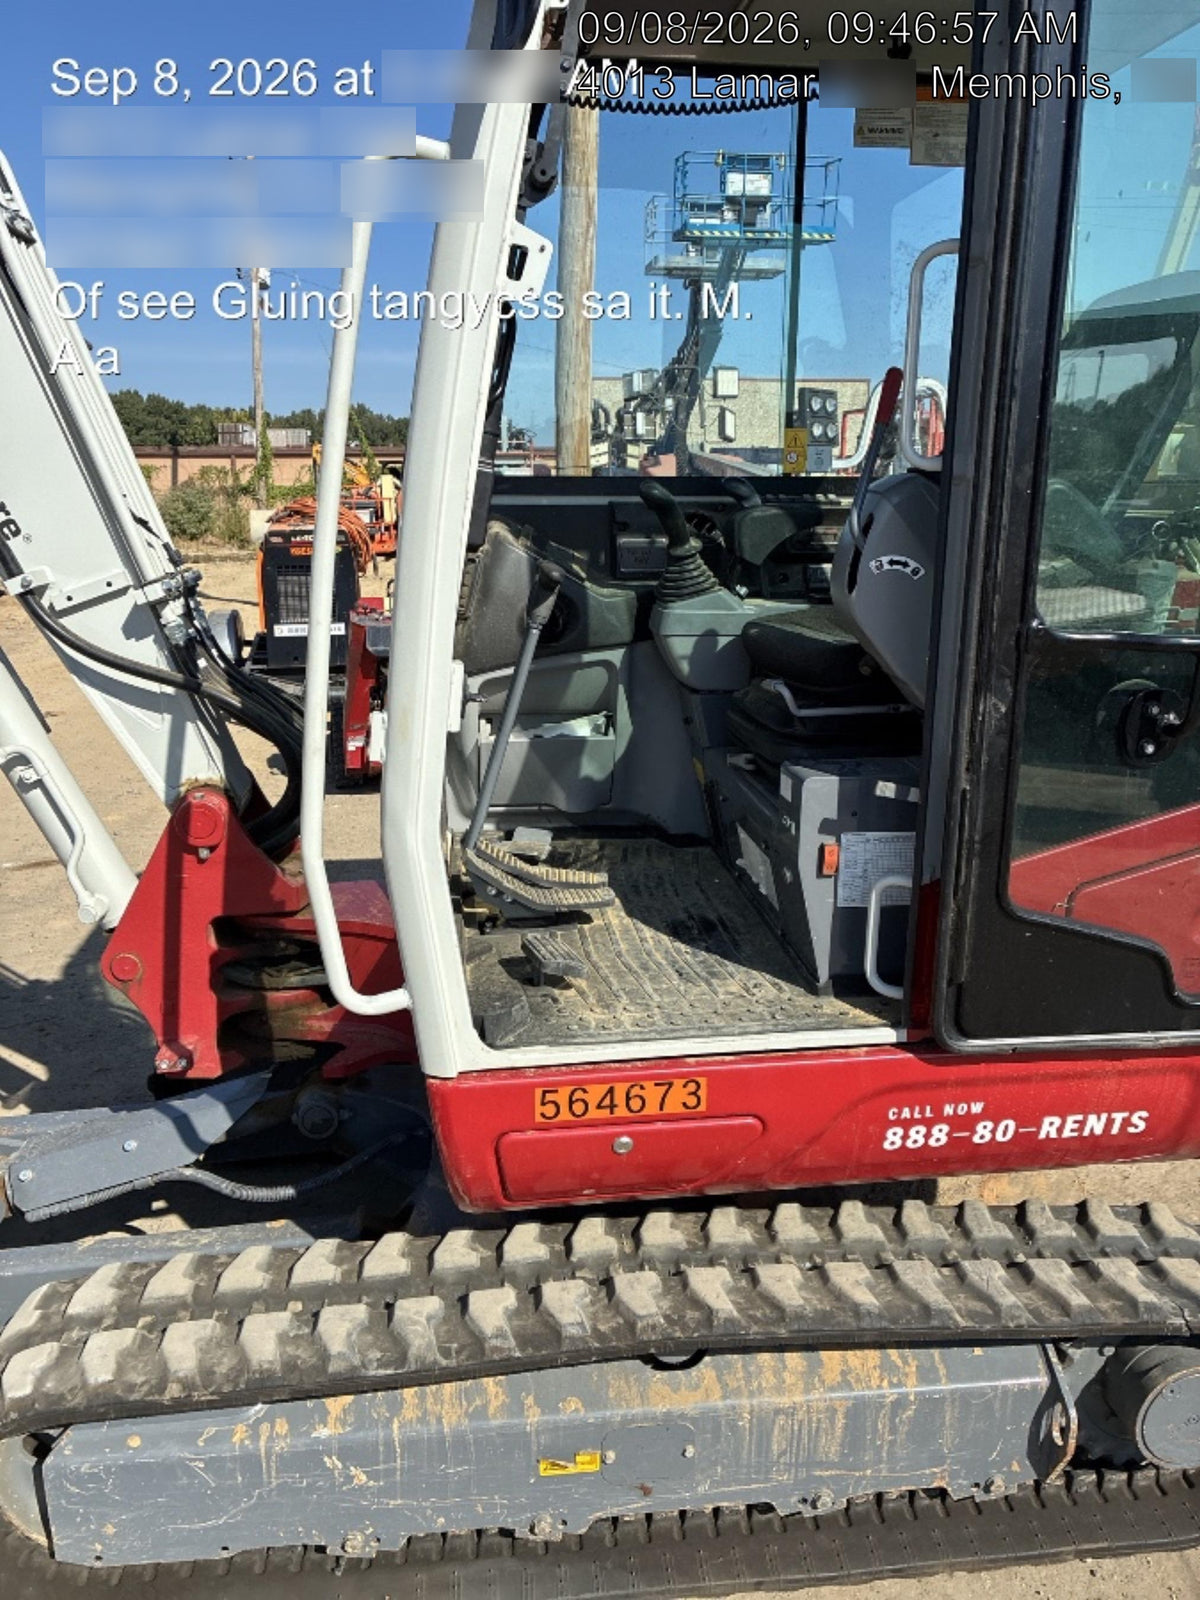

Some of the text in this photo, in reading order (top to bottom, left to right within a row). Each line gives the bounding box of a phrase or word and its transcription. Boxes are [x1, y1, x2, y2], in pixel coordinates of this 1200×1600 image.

[539, 1078, 702, 1121] 564673
[888, 1101, 985, 1121] CALL NOW
[882, 1110, 1150, 1151] 888-80-RENTS
